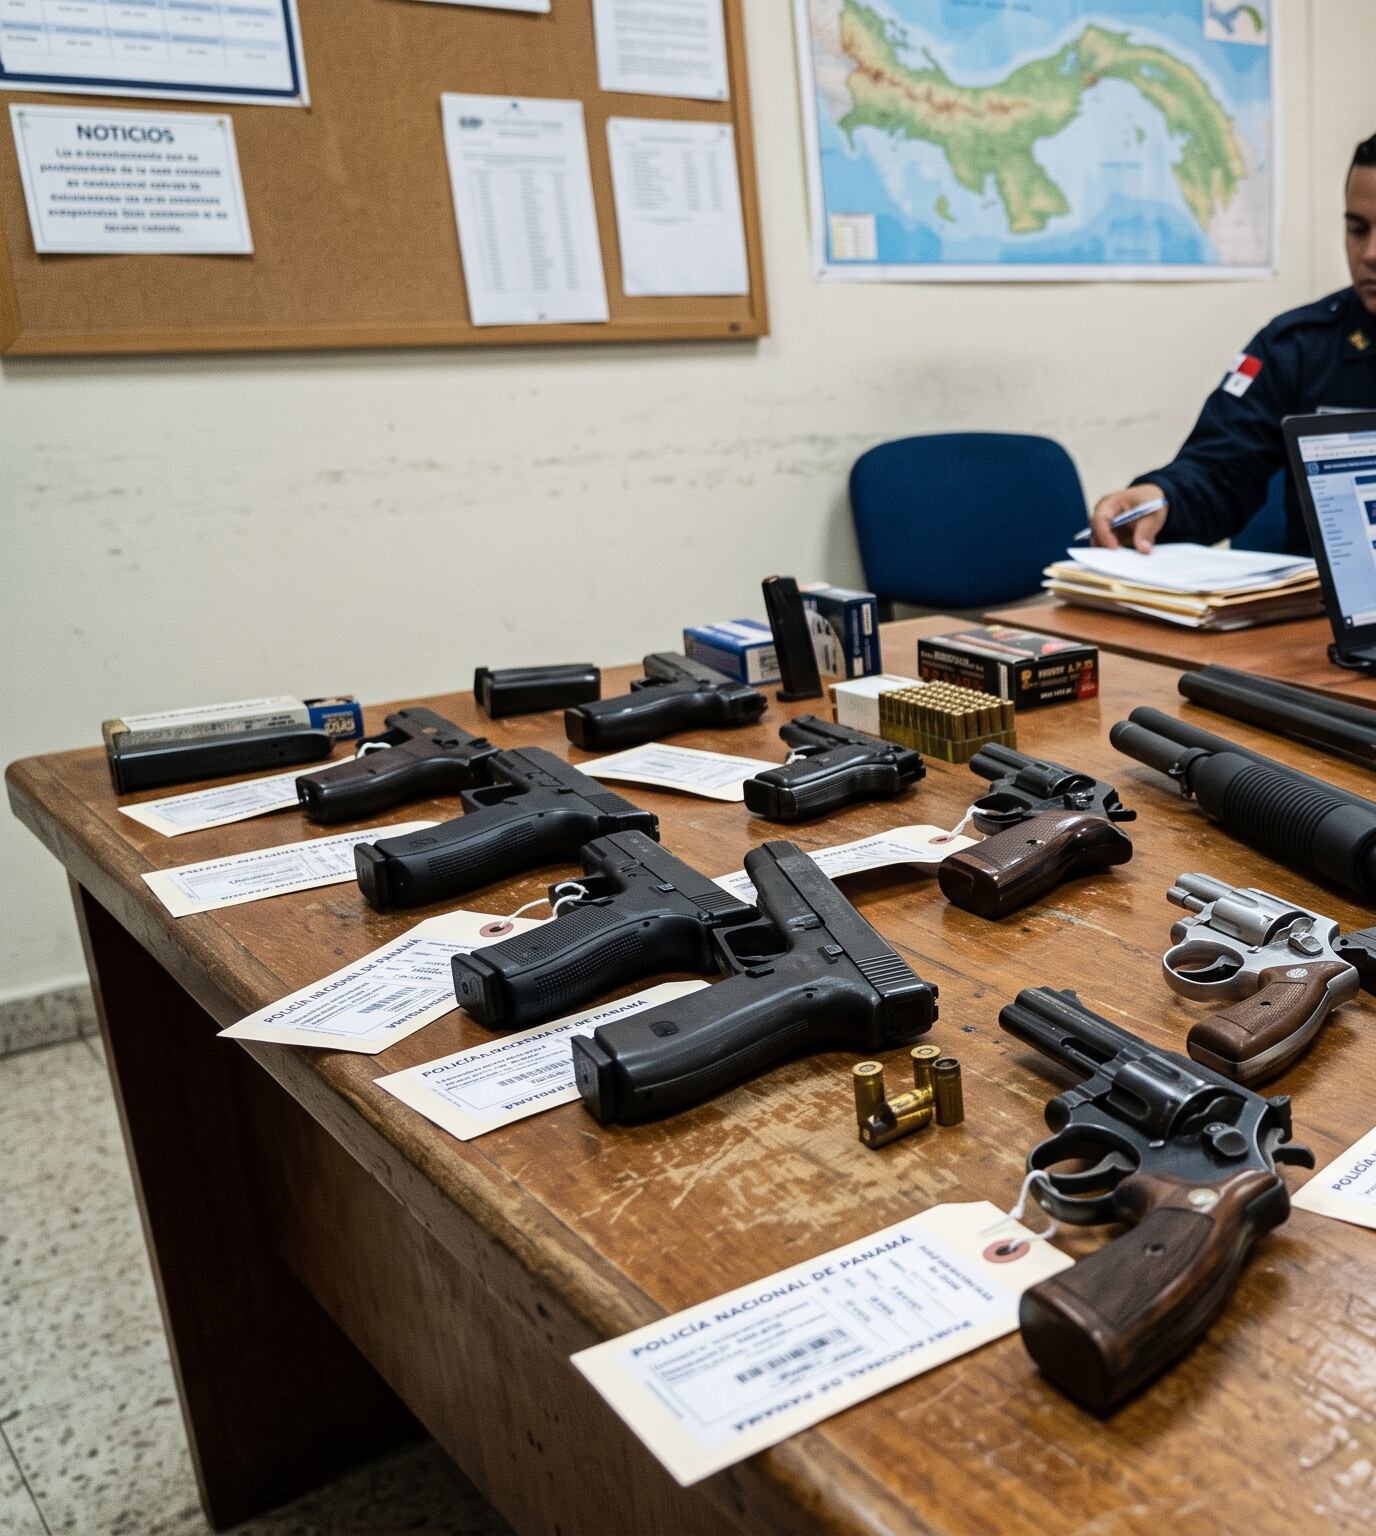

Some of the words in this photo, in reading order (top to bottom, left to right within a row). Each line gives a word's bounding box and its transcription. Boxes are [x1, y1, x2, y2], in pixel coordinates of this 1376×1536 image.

[1331, 1159, 1376, 1191] POLICÍA
[633, 1320, 712, 1357] POLICÍA
[714, 1279, 808, 1323] NACIONAL
[811, 1265, 836, 1281] DE
